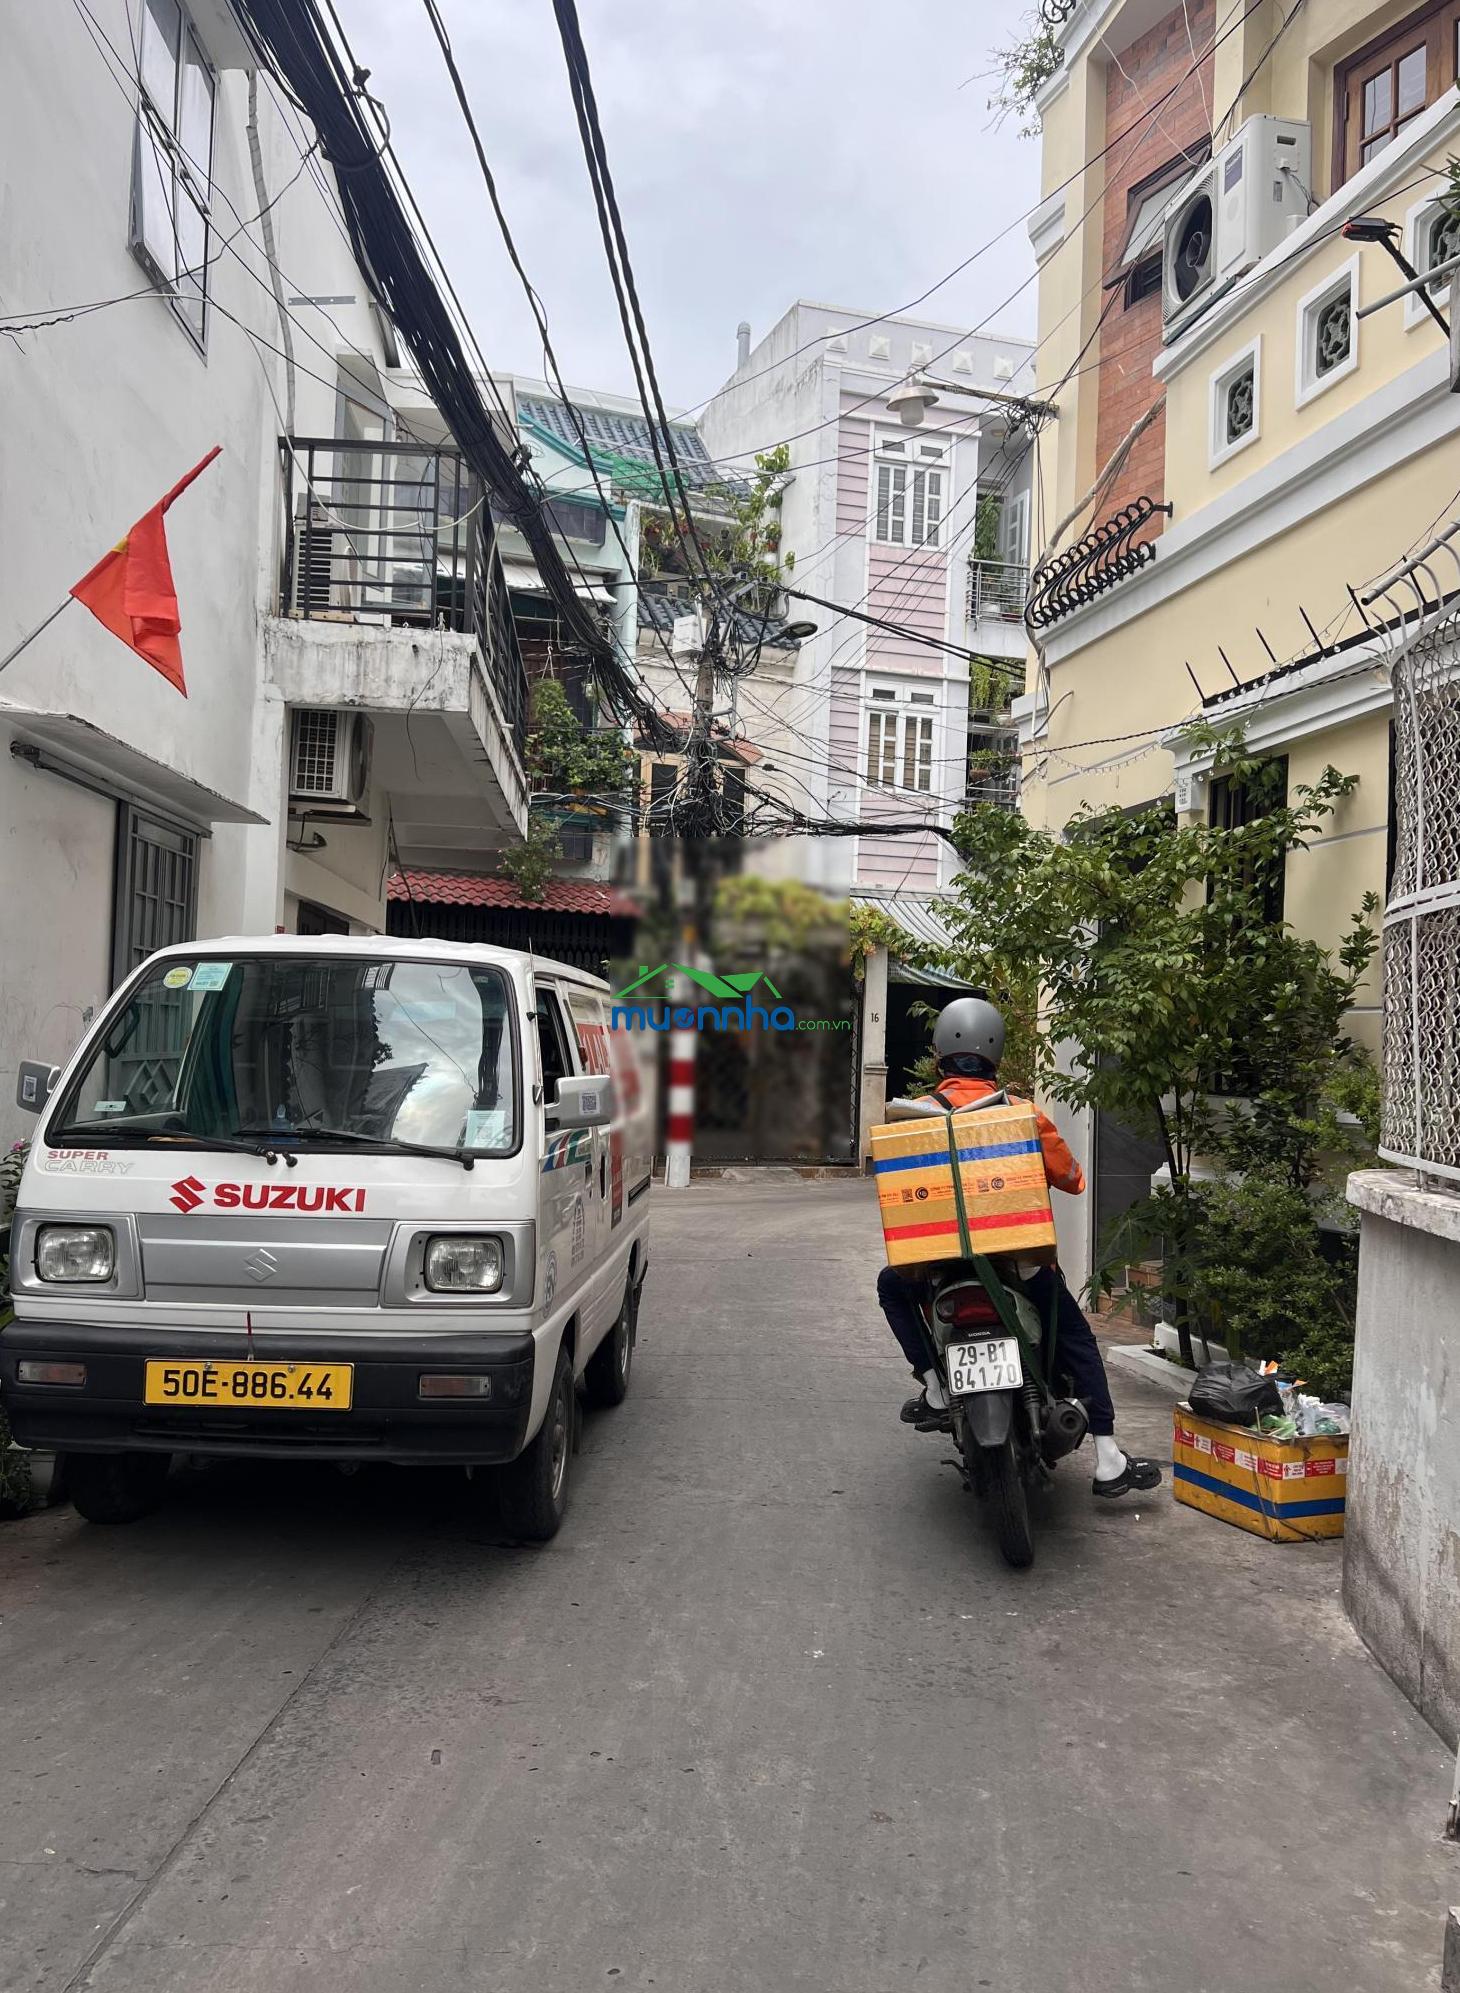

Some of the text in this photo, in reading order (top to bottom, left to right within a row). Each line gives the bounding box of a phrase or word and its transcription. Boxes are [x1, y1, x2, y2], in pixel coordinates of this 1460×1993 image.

[871, 1013, 880, 1023] 16
[45, 1160, 136, 1175] CARRY
[47, 1150, 109, 1161] SUPER
[213, 1183, 367, 1212] SUZUKI
[957, 1341, 1007, 1367] 29-B1
[163, 1369, 333, 1400] 50E-886.44
[953, 1363, 1017, 1391] 841.70
